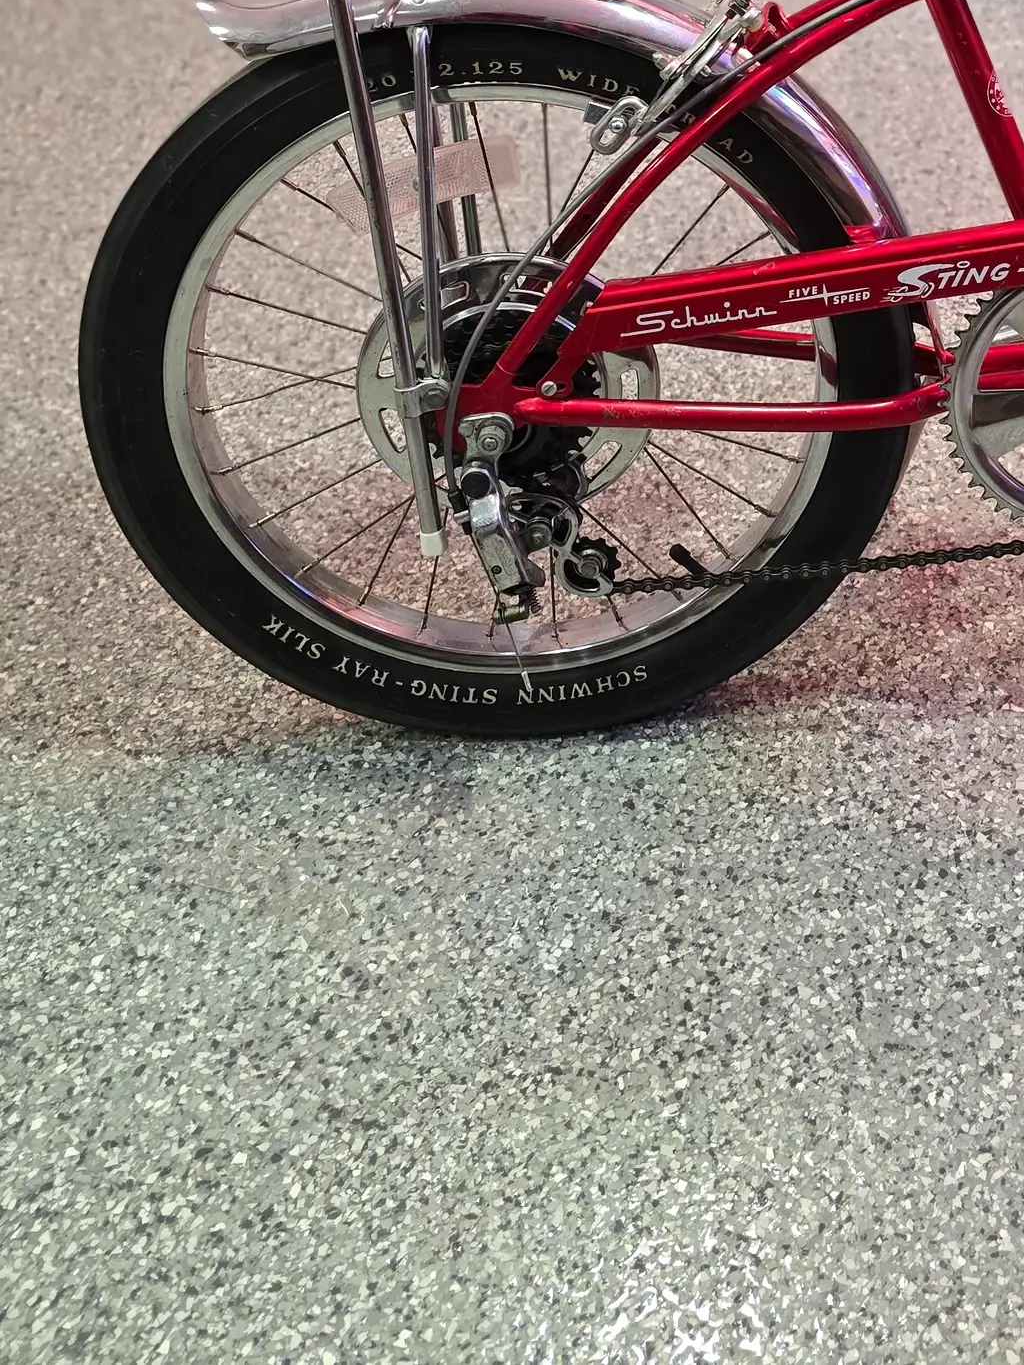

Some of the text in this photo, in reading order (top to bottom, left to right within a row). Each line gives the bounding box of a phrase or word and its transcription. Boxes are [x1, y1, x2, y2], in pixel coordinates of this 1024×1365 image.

[438, 61, 524, 77] 2.125
[788, 285, 818, 299] FIVE
[833, 291, 871, 305] SPEED
[620, 302, 778, 337] Schwinn
[261, 613, 327, 661] SLIK
[516, 664, 649, 706] SCHWINN
